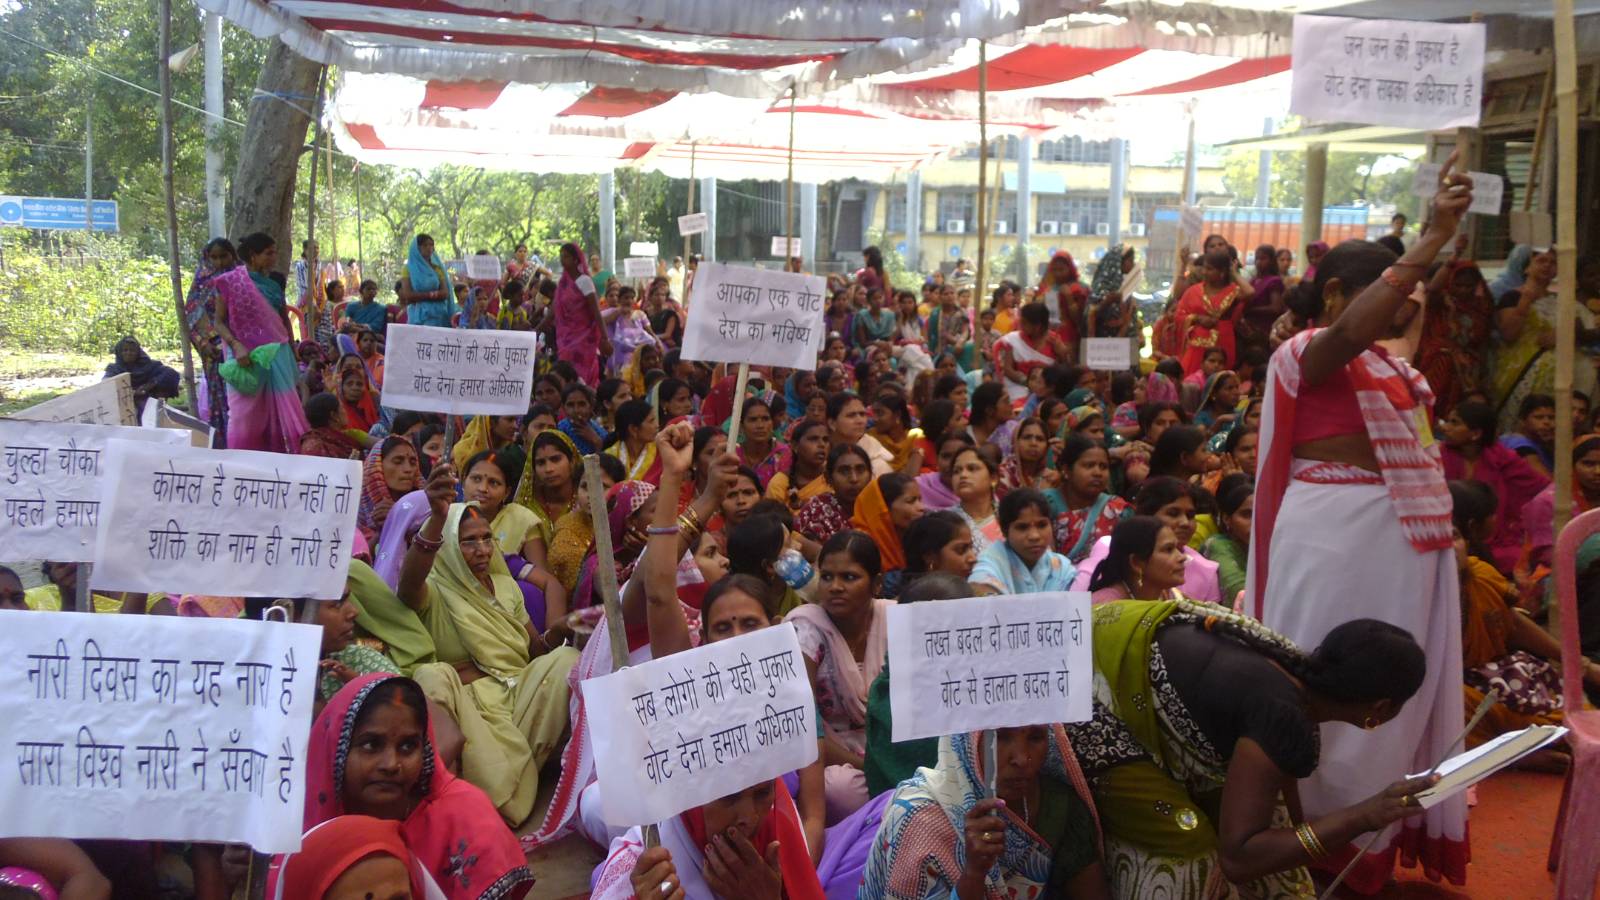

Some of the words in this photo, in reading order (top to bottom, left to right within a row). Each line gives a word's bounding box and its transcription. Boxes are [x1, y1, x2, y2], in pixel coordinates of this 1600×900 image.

[1344, 36, 1365, 58] जन
[1369, 37, 1389, 60] जन
[1393, 32, 1409, 61] की
[1414, 40, 1444, 71] पुकार
[1450, 33, 1460, 66] है
[717, 283, 762, 306] आपका
[768, 288, 790, 311] एक
[797, 285, 821, 312] वोट
[718, 312, 740, 340] देश
[748, 321, 766, 342] का
[772, 318, 811, 346] भविष्य
[416, 342, 432, 361] सब
[437, 337, 461, 364] लोगों
[466, 340, 478, 365] की
[483, 340, 500, 366] यही
[504, 347, 528, 372] पुकार
[414, 369, 432, 393] वोट
[437, 371, 455, 396] देना
[459, 379, 484, 397] हमारा
[488, 373, 525, 399] अधिकार
[5, 489, 46, 527] पहले
[55, 500, 100, 528] हमारा
[153, 460, 204, 504] कोमल
[213, 464, 225, 507] है
[234, 468, 291, 509] कमजोर
[299, 475, 328, 514] नहीं
[335, 475, 352, 515] तो
[148, 519, 189, 558] शक्ति
[198, 532, 220, 563] का
[229, 534, 258, 564] नाम
[266, 525, 282, 566] ही
[291, 527, 322, 568] नारी
[329, 528, 341, 570] है
[924, 630, 950, 660] तख्त
[956, 627, 983, 655] बदल
[989, 614, 1001, 651] दो
[1007, 622, 1030, 649] ताज
[1036, 620, 1063, 648] बदल
[1069, 608, 1083, 647] दो
[27, 638, 70, 700] नारी
[82, 638, 141, 703] दिवस
[151, 659, 180, 704] का
[191, 662, 225, 708] यह
[235, 662, 273, 709] नारा
[279, 647, 297, 716] है
[632, 692, 657, 726] सब
[661, 666, 699, 717] लोगों
[702, 661, 725, 704] की
[727, 652, 756, 695] यही
[759, 650, 797, 698] पुकार
[940, 670, 960, 709] वोट
[967, 667, 977, 705] से
[983, 674, 1018, 706] हालात
[1023, 671, 1050, 700] बदल
[1056, 660, 1070, 697] दो
[17, 742, 64, 787] सारा
[75, 725, 125, 789] विश्व
[136, 729, 180, 790] नारी
[191, 728, 208, 791] ने
[278, 736, 294, 804] है
[644, 741, 673, 785] वोट
[676, 732, 707, 774] देना
[710, 724, 750, 764] हमारा
[755, 703, 808, 747] अधिकार
